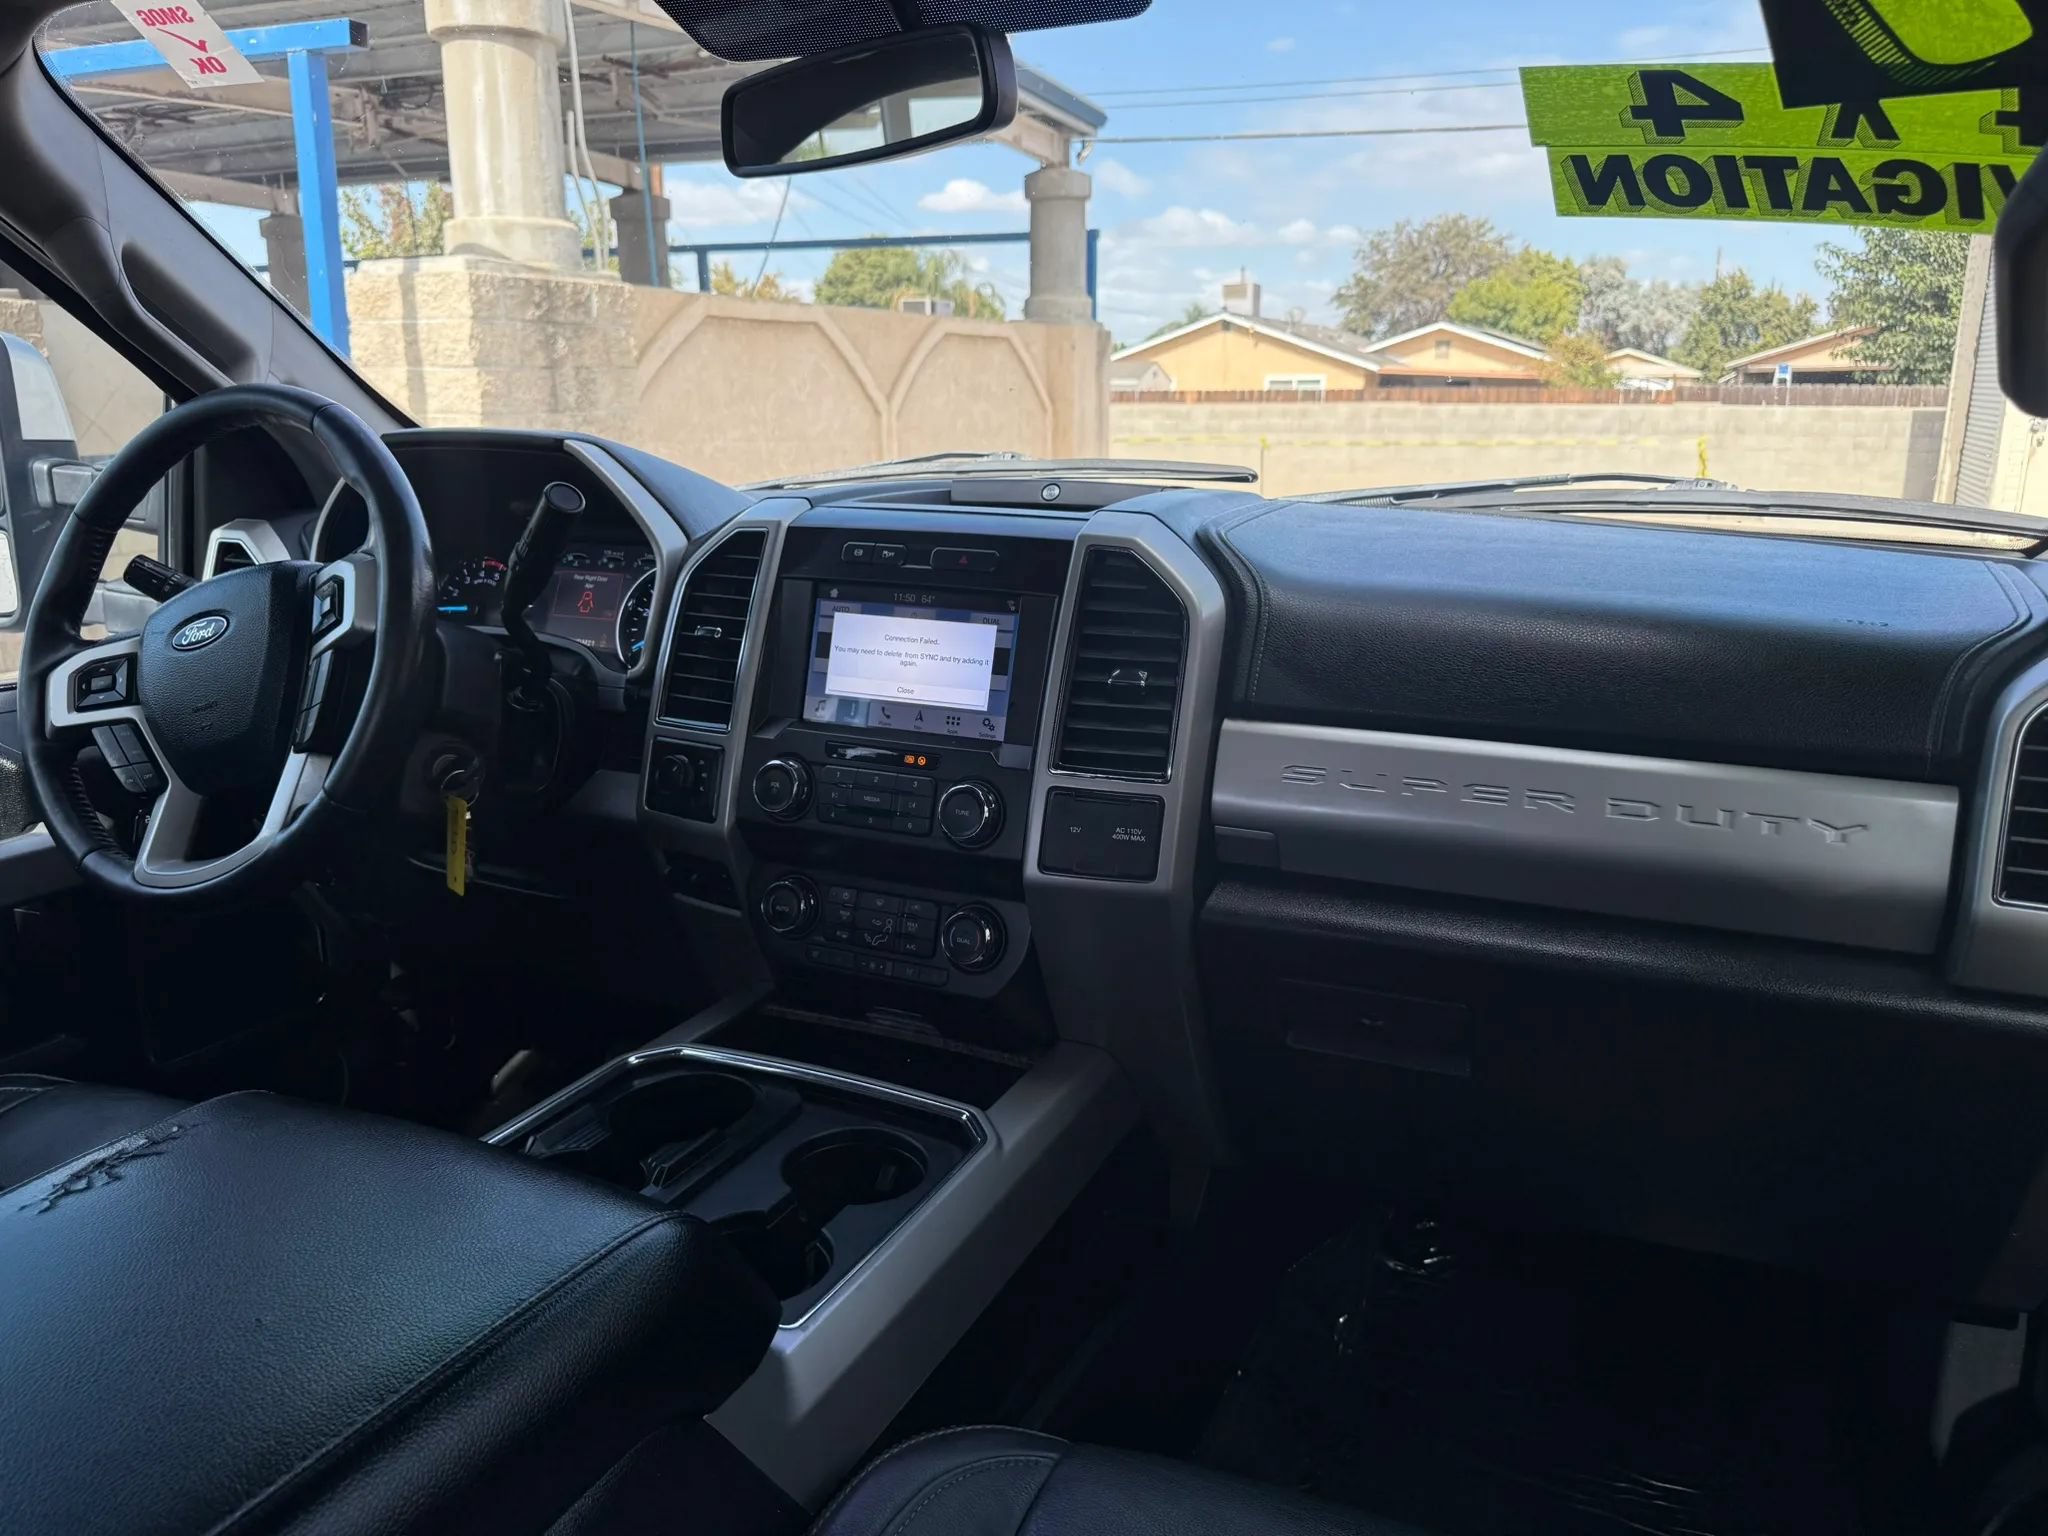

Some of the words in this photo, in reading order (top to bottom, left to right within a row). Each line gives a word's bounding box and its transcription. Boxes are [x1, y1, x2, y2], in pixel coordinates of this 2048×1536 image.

[893, 592, 916, 602] 11:50
[181, 621, 215, 646] Ford
[884, 634, 919, 644] Connection
[834, 644, 846, 653] You
[847, 647, 860, 655] may
[860, 648, 876, 656] need
[876, 649, 883, 657] to
[884, 650, 902, 659] delete
[904, 651, 918, 660] from
[920, 652, 939, 662] SYNC
[940, 655, 952, 663] and
[952, 656, 961, 665] try
[962, 657, 983, 667] adding
[897, 686, 915, 695] Close
[1281, 765, 1575, 814] SUPER
[1606, 796, 1868, 845] DUTY
[955, 808, 970, 817] TUNE
[1127, 827, 1143, 836] 110V
